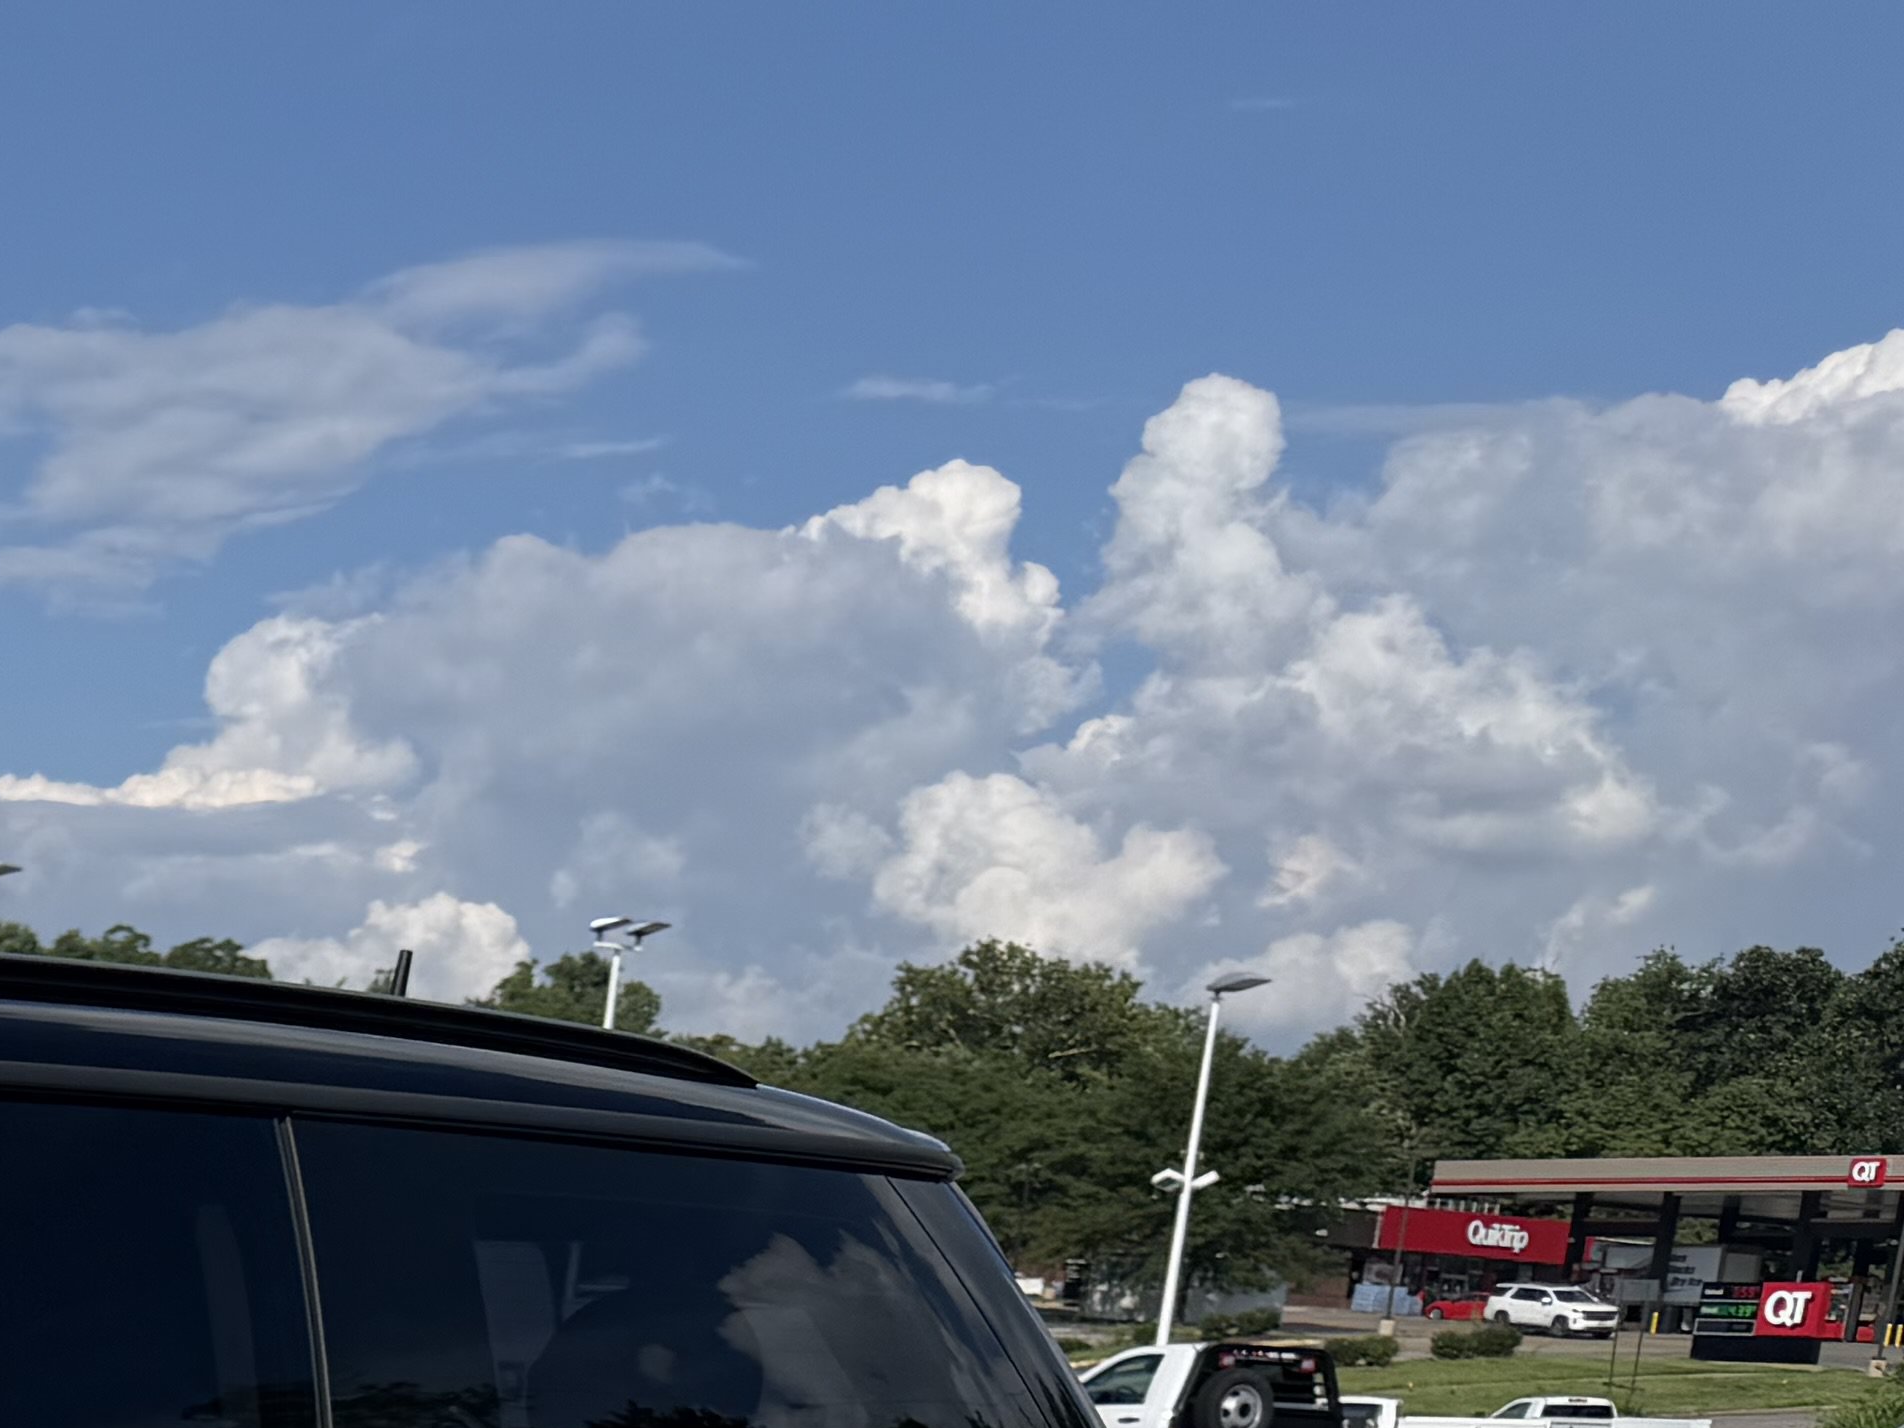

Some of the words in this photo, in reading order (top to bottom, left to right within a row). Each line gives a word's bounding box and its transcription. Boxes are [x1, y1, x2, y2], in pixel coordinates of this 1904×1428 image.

[1852, 1161, 1880, 1182] QT
[1468, 1220, 1529, 1253] QuikTrip
[1764, 1290, 1812, 1326] QT
